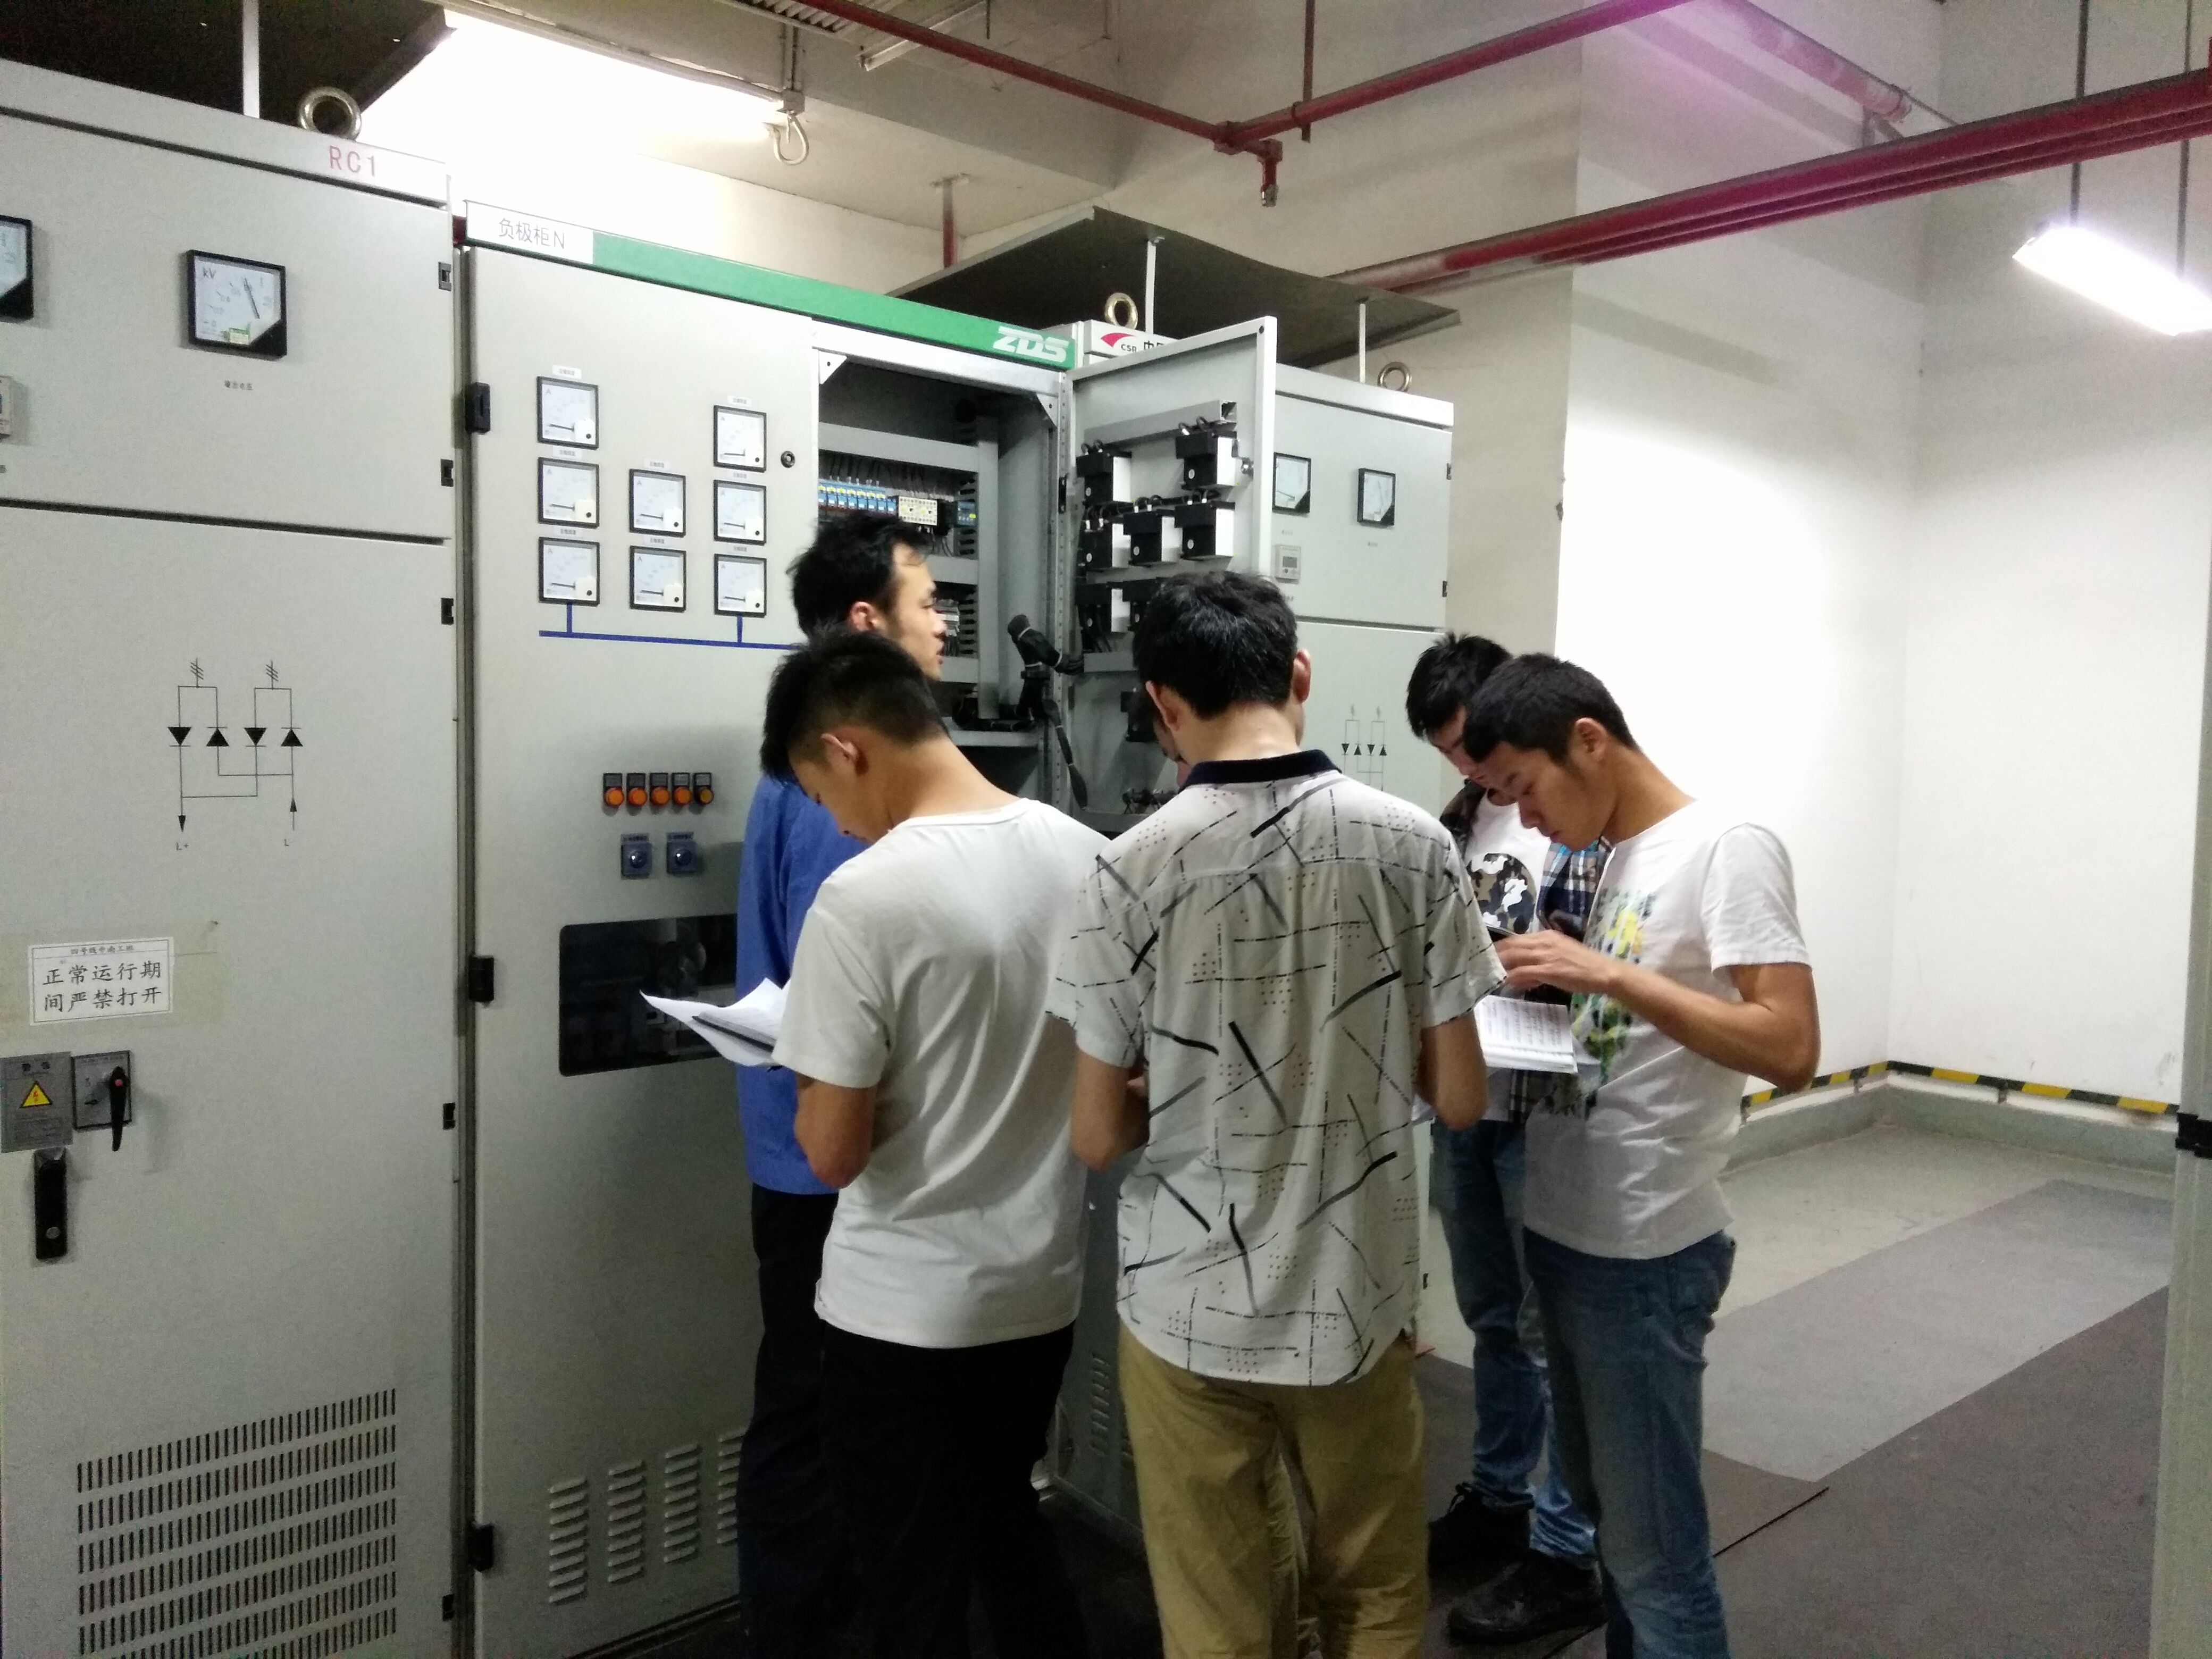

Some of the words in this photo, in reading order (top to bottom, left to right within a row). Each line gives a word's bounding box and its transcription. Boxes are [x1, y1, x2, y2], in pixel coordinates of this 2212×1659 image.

[330, 145, 374, 177] RC1
[499, 217, 565, 249] 负极柜N
[1144, 340, 1164, 350] 中
[43, 960, 161, 985] 正常运行期
[44, 986, 162, 1012] 间严禁打开
